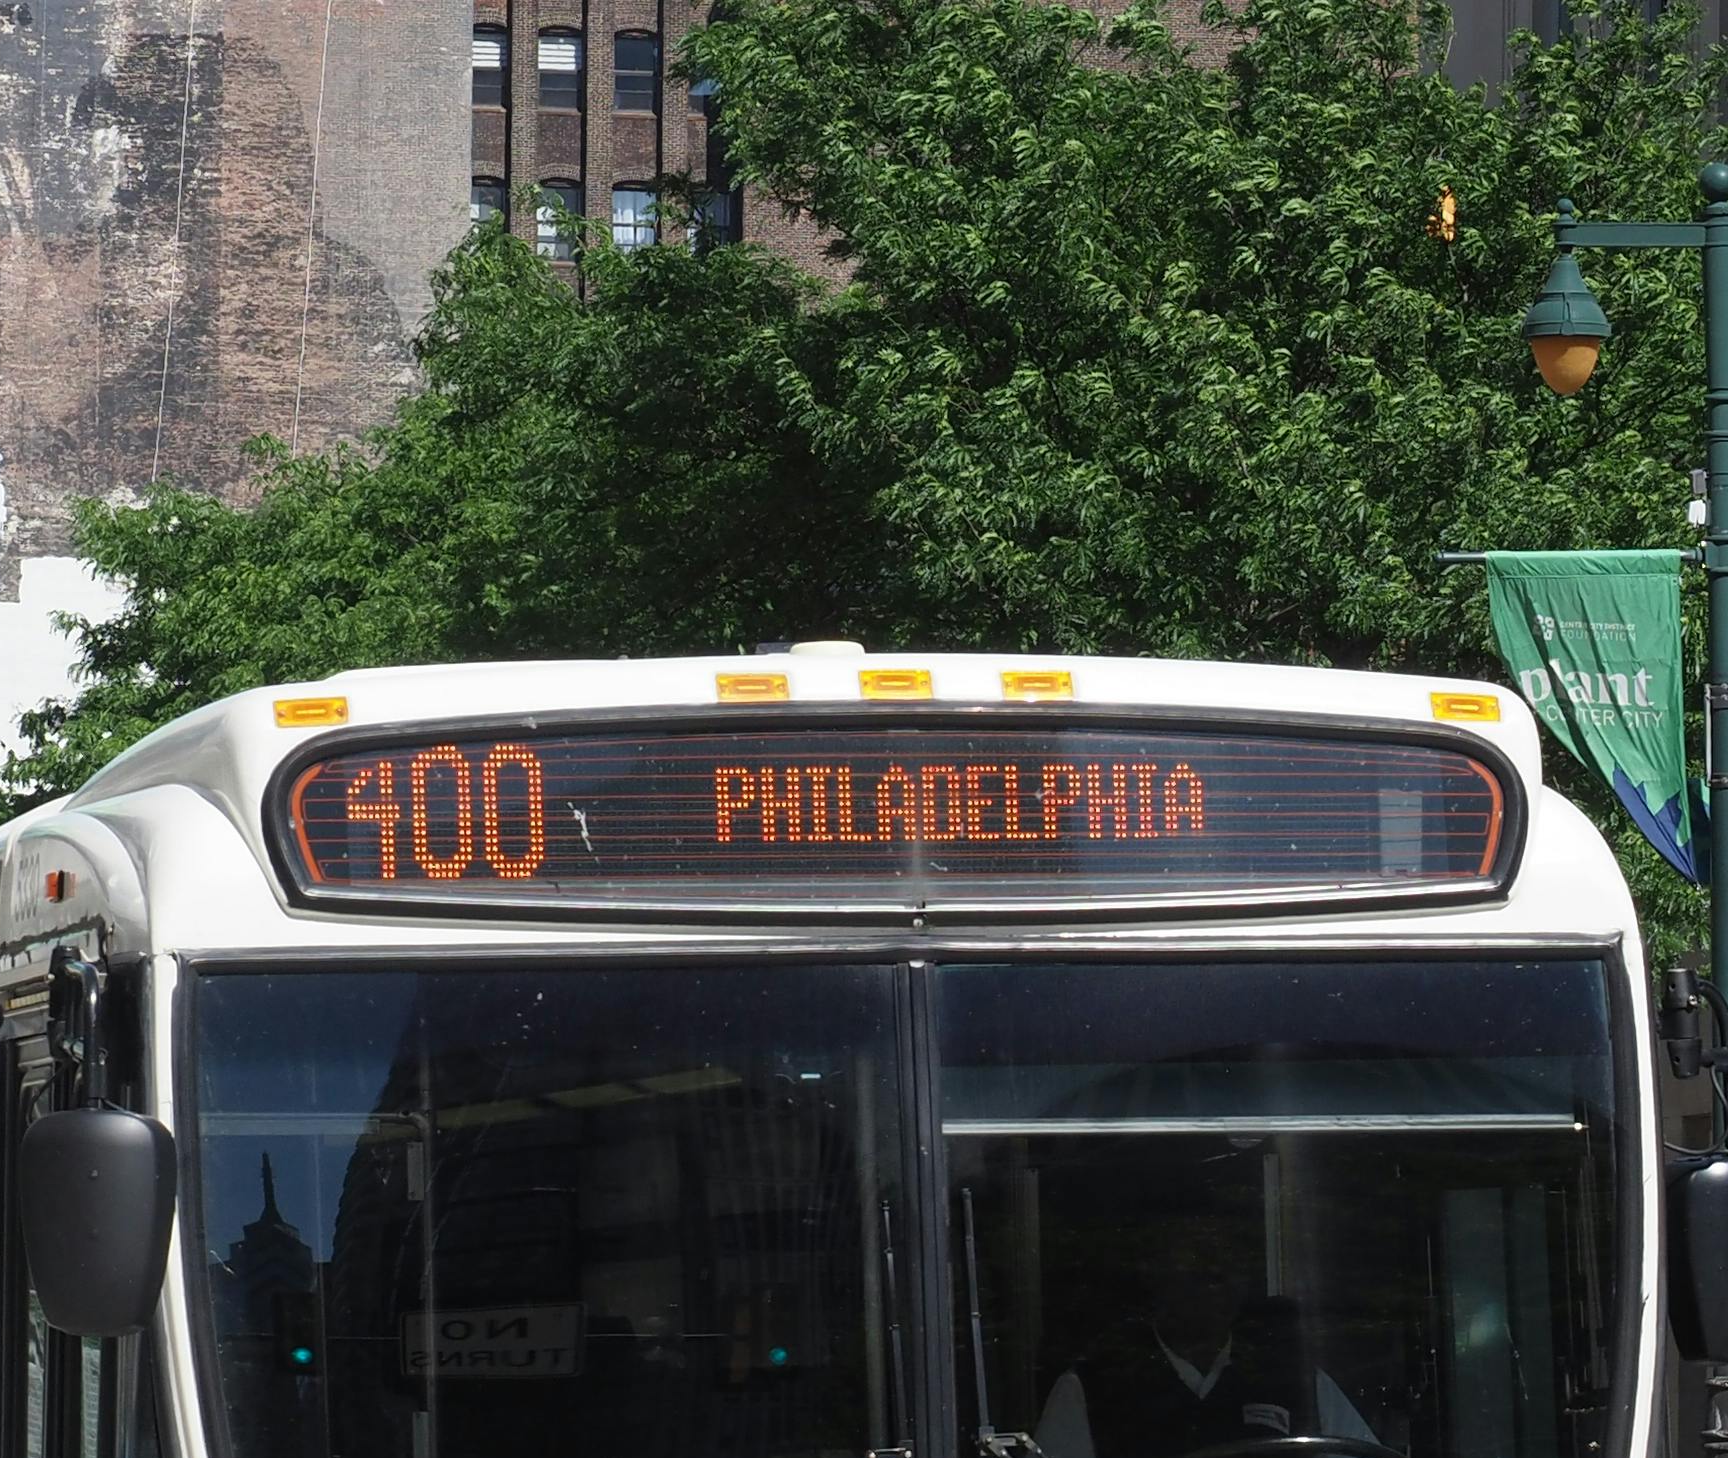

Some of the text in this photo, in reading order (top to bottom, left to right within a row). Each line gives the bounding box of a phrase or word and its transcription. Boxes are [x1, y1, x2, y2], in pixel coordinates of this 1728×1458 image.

[1519, 658, 1655, 710] plant
[1546, 705, 1663, 728] CTER CITY
[346, 743, 1206, 879] 400 PHILADELPHIA
